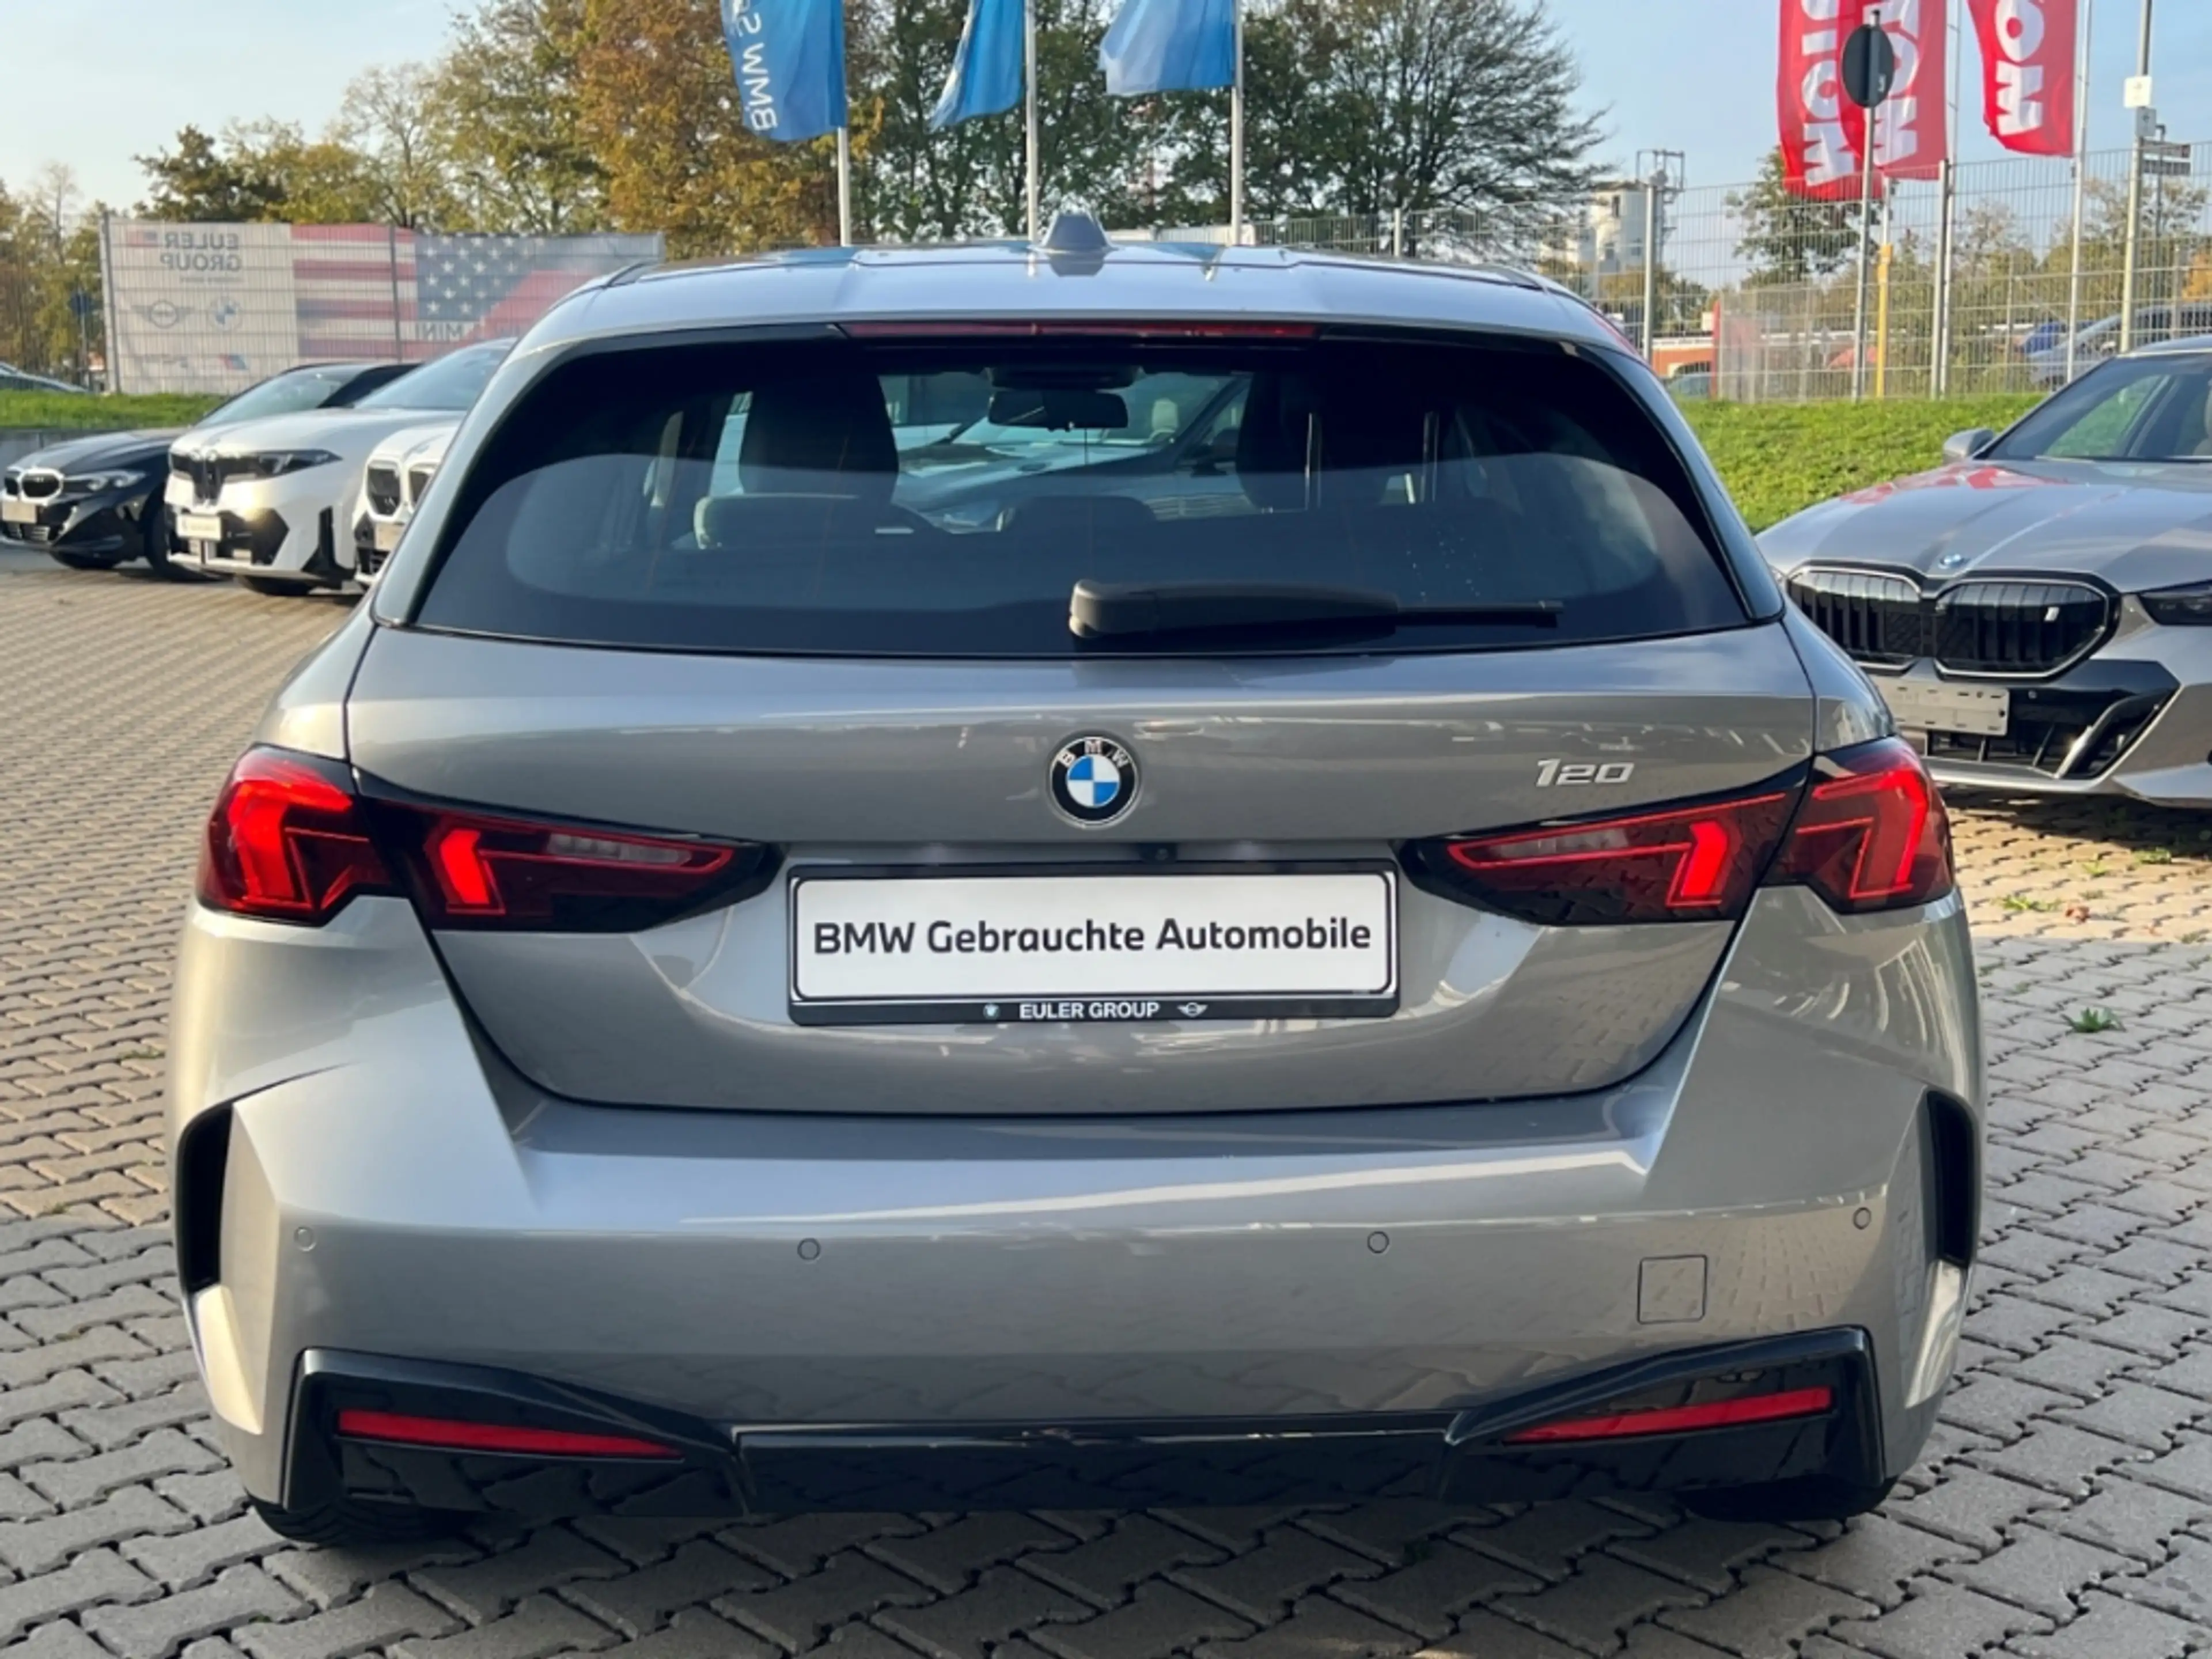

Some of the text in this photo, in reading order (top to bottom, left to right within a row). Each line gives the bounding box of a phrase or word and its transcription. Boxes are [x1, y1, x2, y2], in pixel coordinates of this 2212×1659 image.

[1056, 740, 1130, 768] BMW
[1536, 758, 1635, 787] 120
[815, 917, 1370, 953] BMW Gebrauchte Automobile
[1019, 1001, 1160, 1019] EULER GROUP
